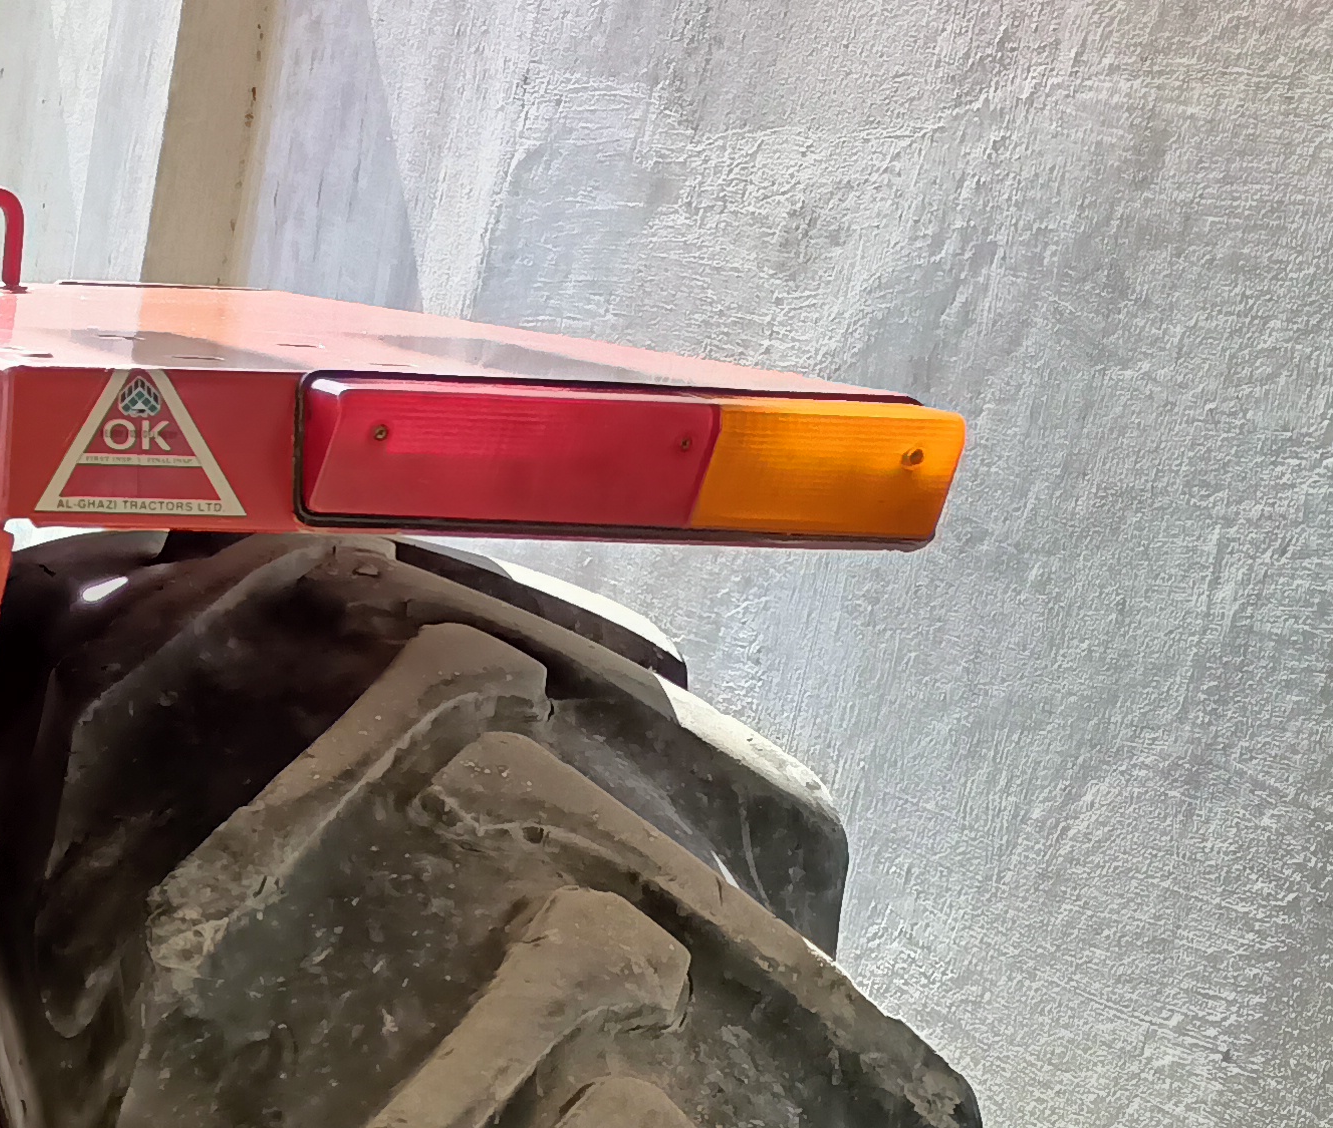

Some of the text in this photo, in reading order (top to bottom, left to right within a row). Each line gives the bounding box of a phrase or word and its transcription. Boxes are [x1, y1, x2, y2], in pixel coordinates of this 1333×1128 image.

[103, 419, 171, 450] OK
[56, 499, 117, 510] AL-GHAZI
[123, 500, 193, 512] TRACTORS
